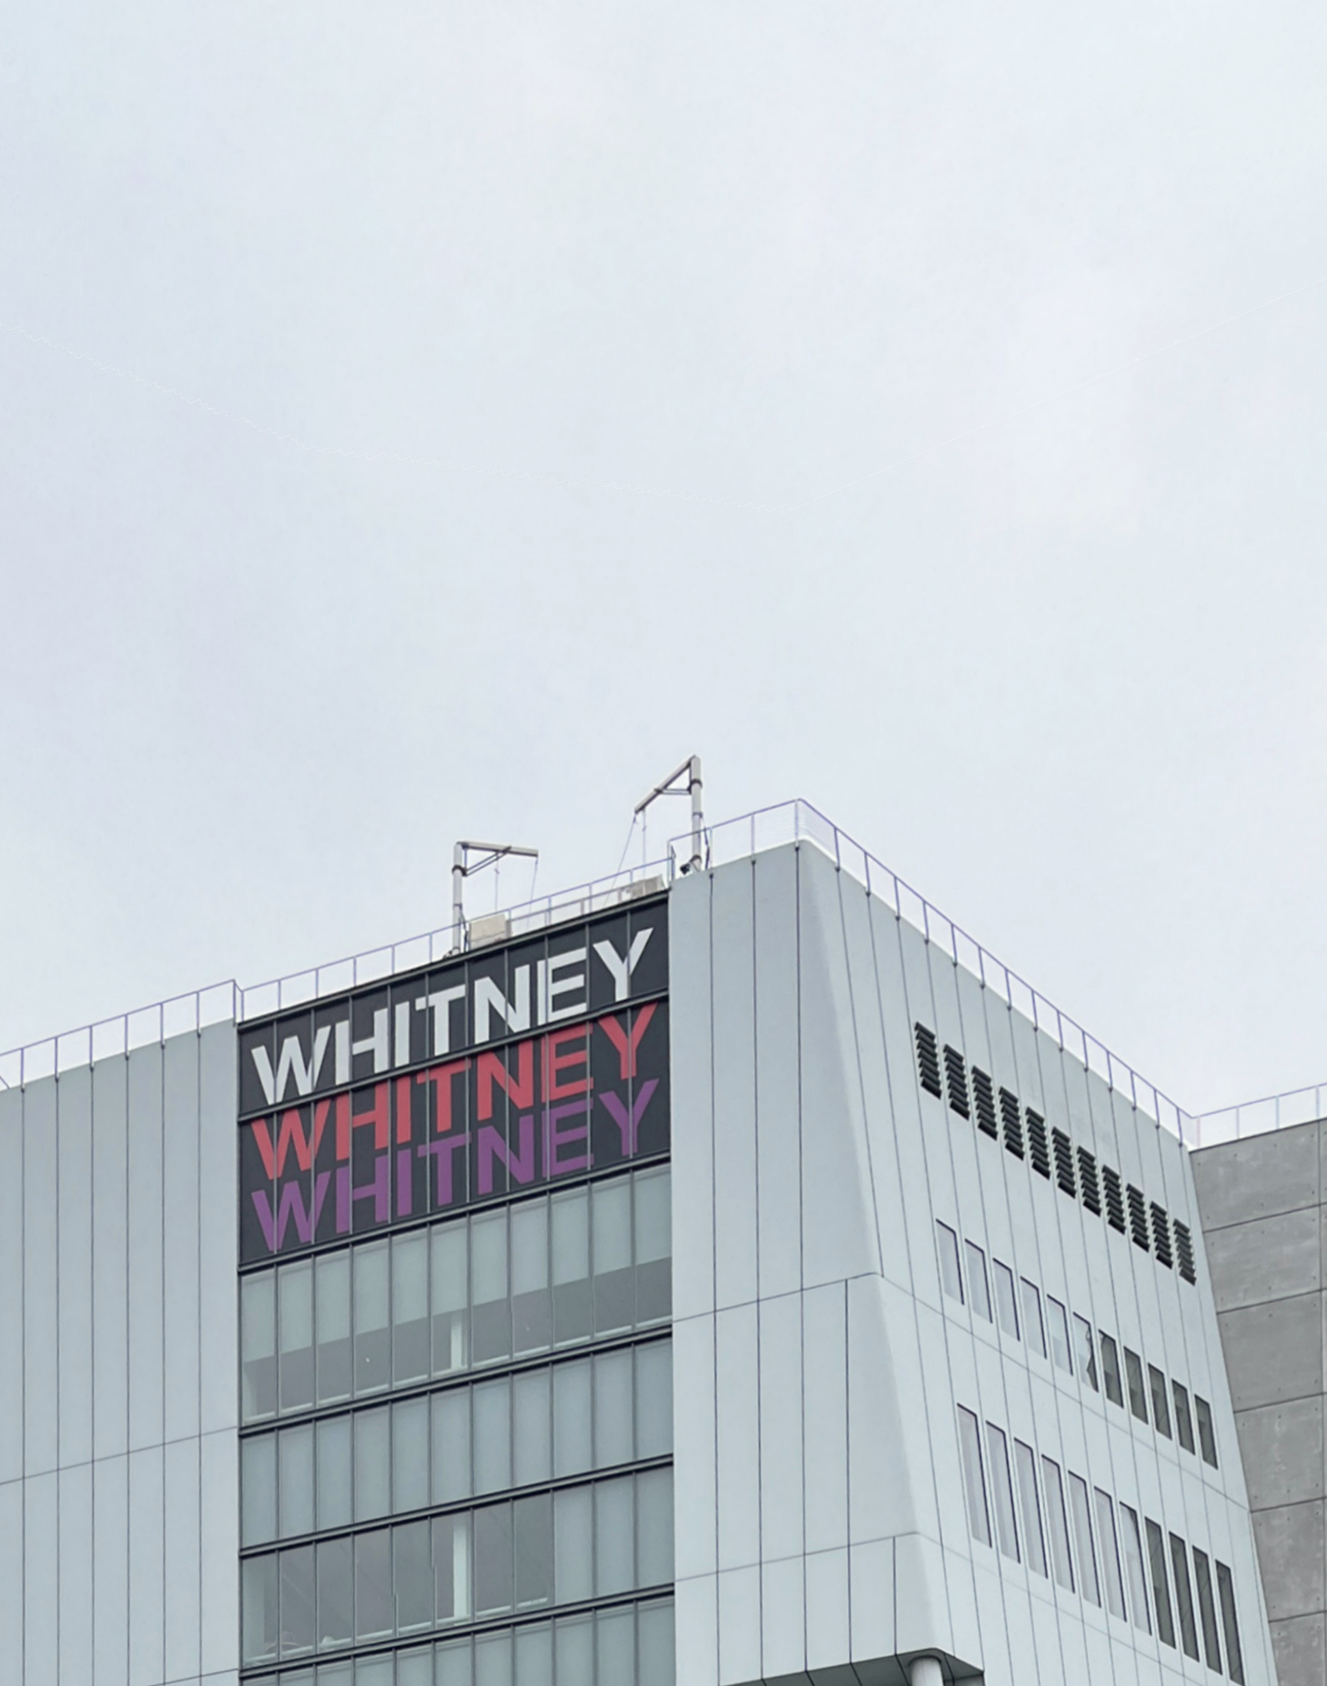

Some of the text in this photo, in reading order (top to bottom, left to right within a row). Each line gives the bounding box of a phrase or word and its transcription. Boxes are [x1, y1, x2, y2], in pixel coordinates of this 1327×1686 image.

[251, 926, 654, 1108] WHITNEY
[251, 1002, 657, 1181] WHITNEY
[251, 1077, 659, 1253] WHITNEY
